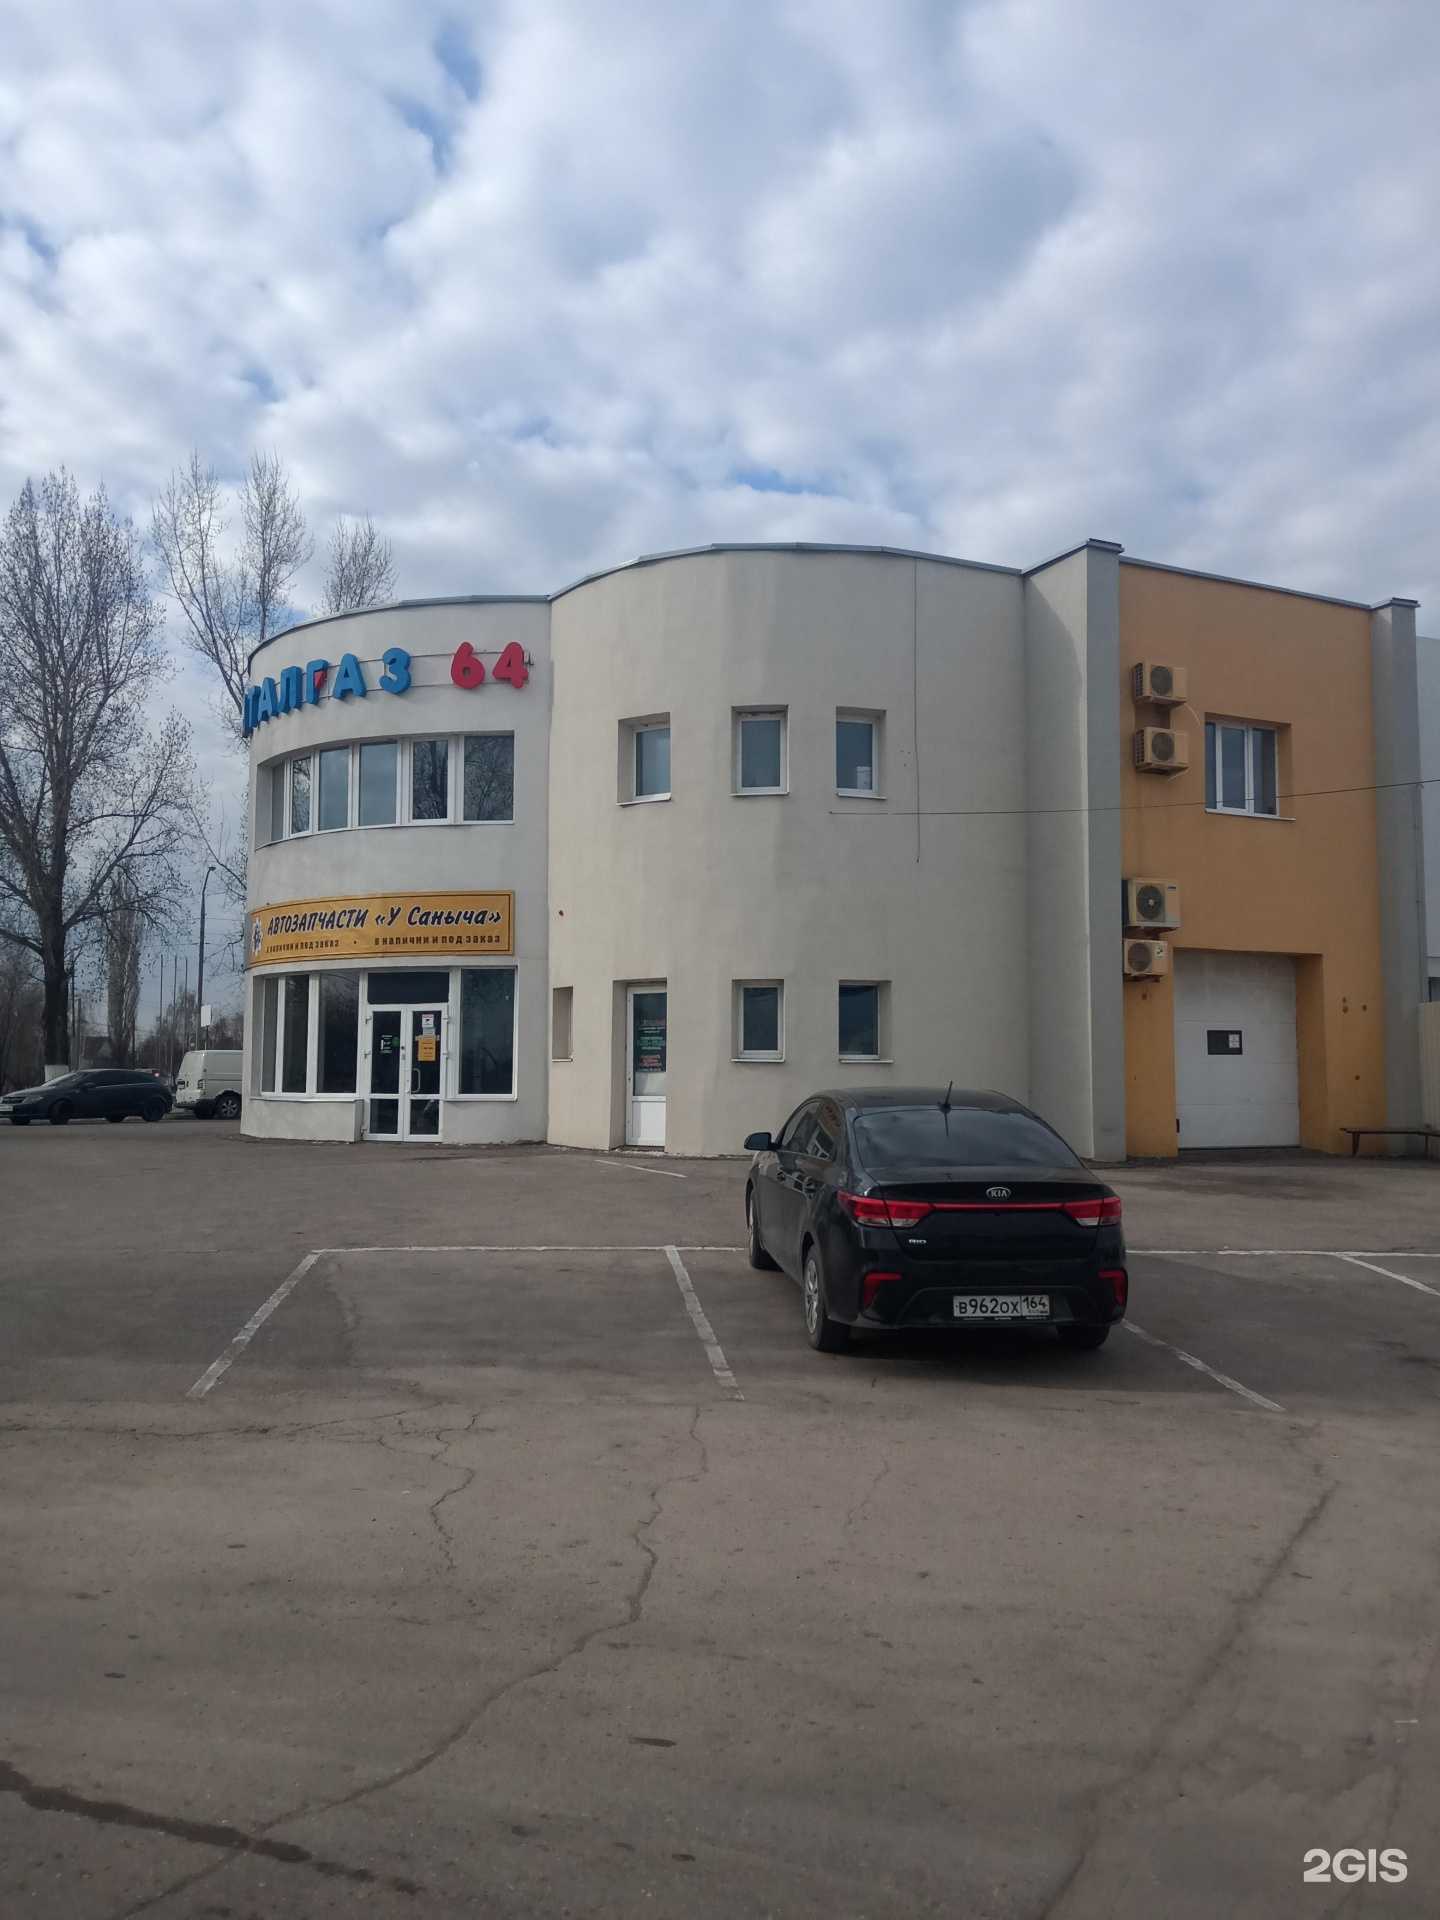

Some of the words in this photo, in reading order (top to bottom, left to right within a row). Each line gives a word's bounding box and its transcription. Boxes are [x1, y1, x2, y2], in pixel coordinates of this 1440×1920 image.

[451, 641, 529, 689] 64
[267, 908, 369, 936] АВТОЗАПЧАСТИ
[407, 906, 502, 926] Саныча»
[441, 935, 462, 944] под
[465, 935, 501, 944] заказ
[991, 1189, 1008, 1198] KIA
